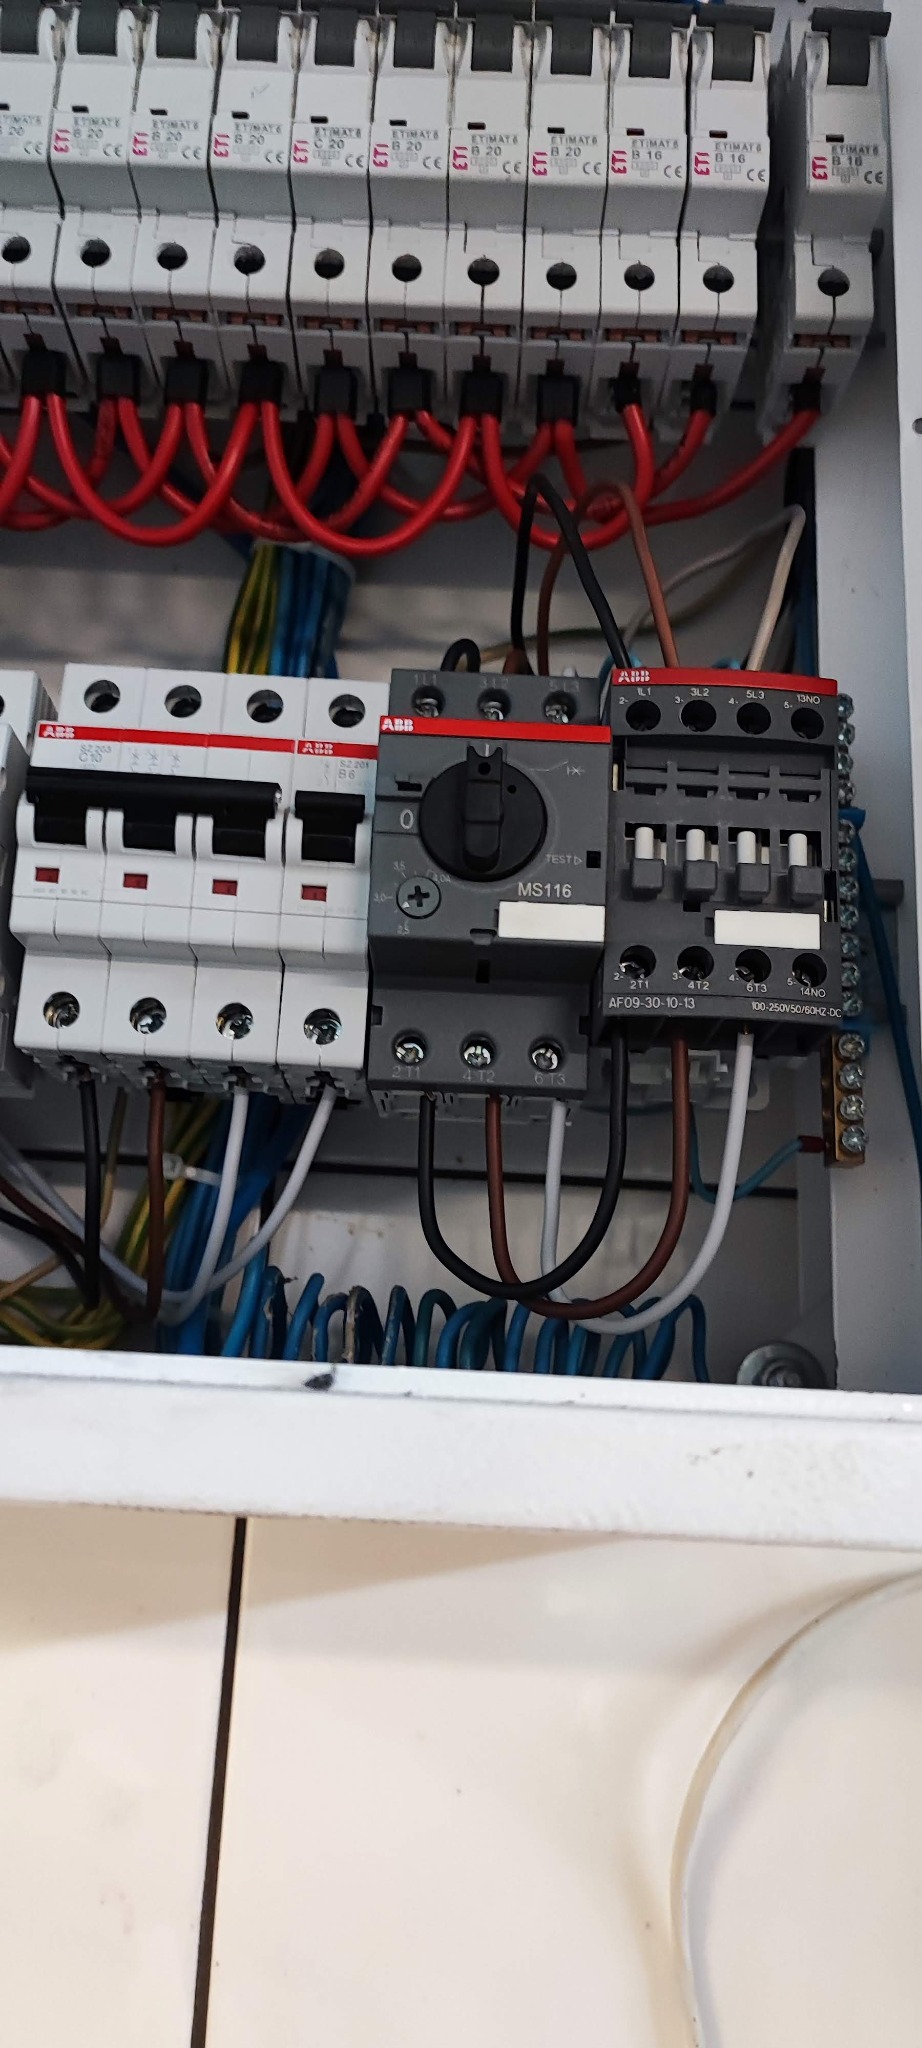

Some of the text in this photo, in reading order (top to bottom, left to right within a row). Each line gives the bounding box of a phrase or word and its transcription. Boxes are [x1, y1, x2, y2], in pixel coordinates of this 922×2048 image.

[88, 128, 104, 138] 20
[166, 132, 182, 142] 20
[54, 129, 70, 152] ETI
[133, 132, 149, 156] ETI
[250, 135, 264, 145] 20
[329, 140, 344, 150] 20
[214, 134, 230, 158] ETI
[406, 142, 422, 151] 20
[486, 146, 501, 156] 20
[294, 140, 309, 163] ETI
[373, 144, 388, 168] ETI
[566, 147, 581, 156] 20
[648, 151, 662, 160] 16
[452, 147, 468, 170] ETI
[611, 151, 627, 174] ETI
[731, 154, 745, 163] 16
[848, 156, 862, 166] 16
[532, 152, 548, 176] ETI
[694, 152, 710, 176] ETI
[812, 157, 828, 180] ETI
[618, 670, 650, 682] ABB
[690, 688, 709, 697] 3L2
[746, 690, 765, 700] 5L3
[797, 694, 820, 704] 13NO
[381, 718, 414, 732] ABB
[43, 726, 74, 738] ABB
[302, 742, 333, 755] ABB
[546, 854, 572, 864] TEST
[518, 882, 572, 898] MS116
[630, 981, 648, 989] 2T1
[688, 981, 709, 990] 4T2
[746, 983, 767, 992] 6T3
[800, 987, 826, 998] 14NO
[609, 997, 696, 1009] AF09-30-10-13
